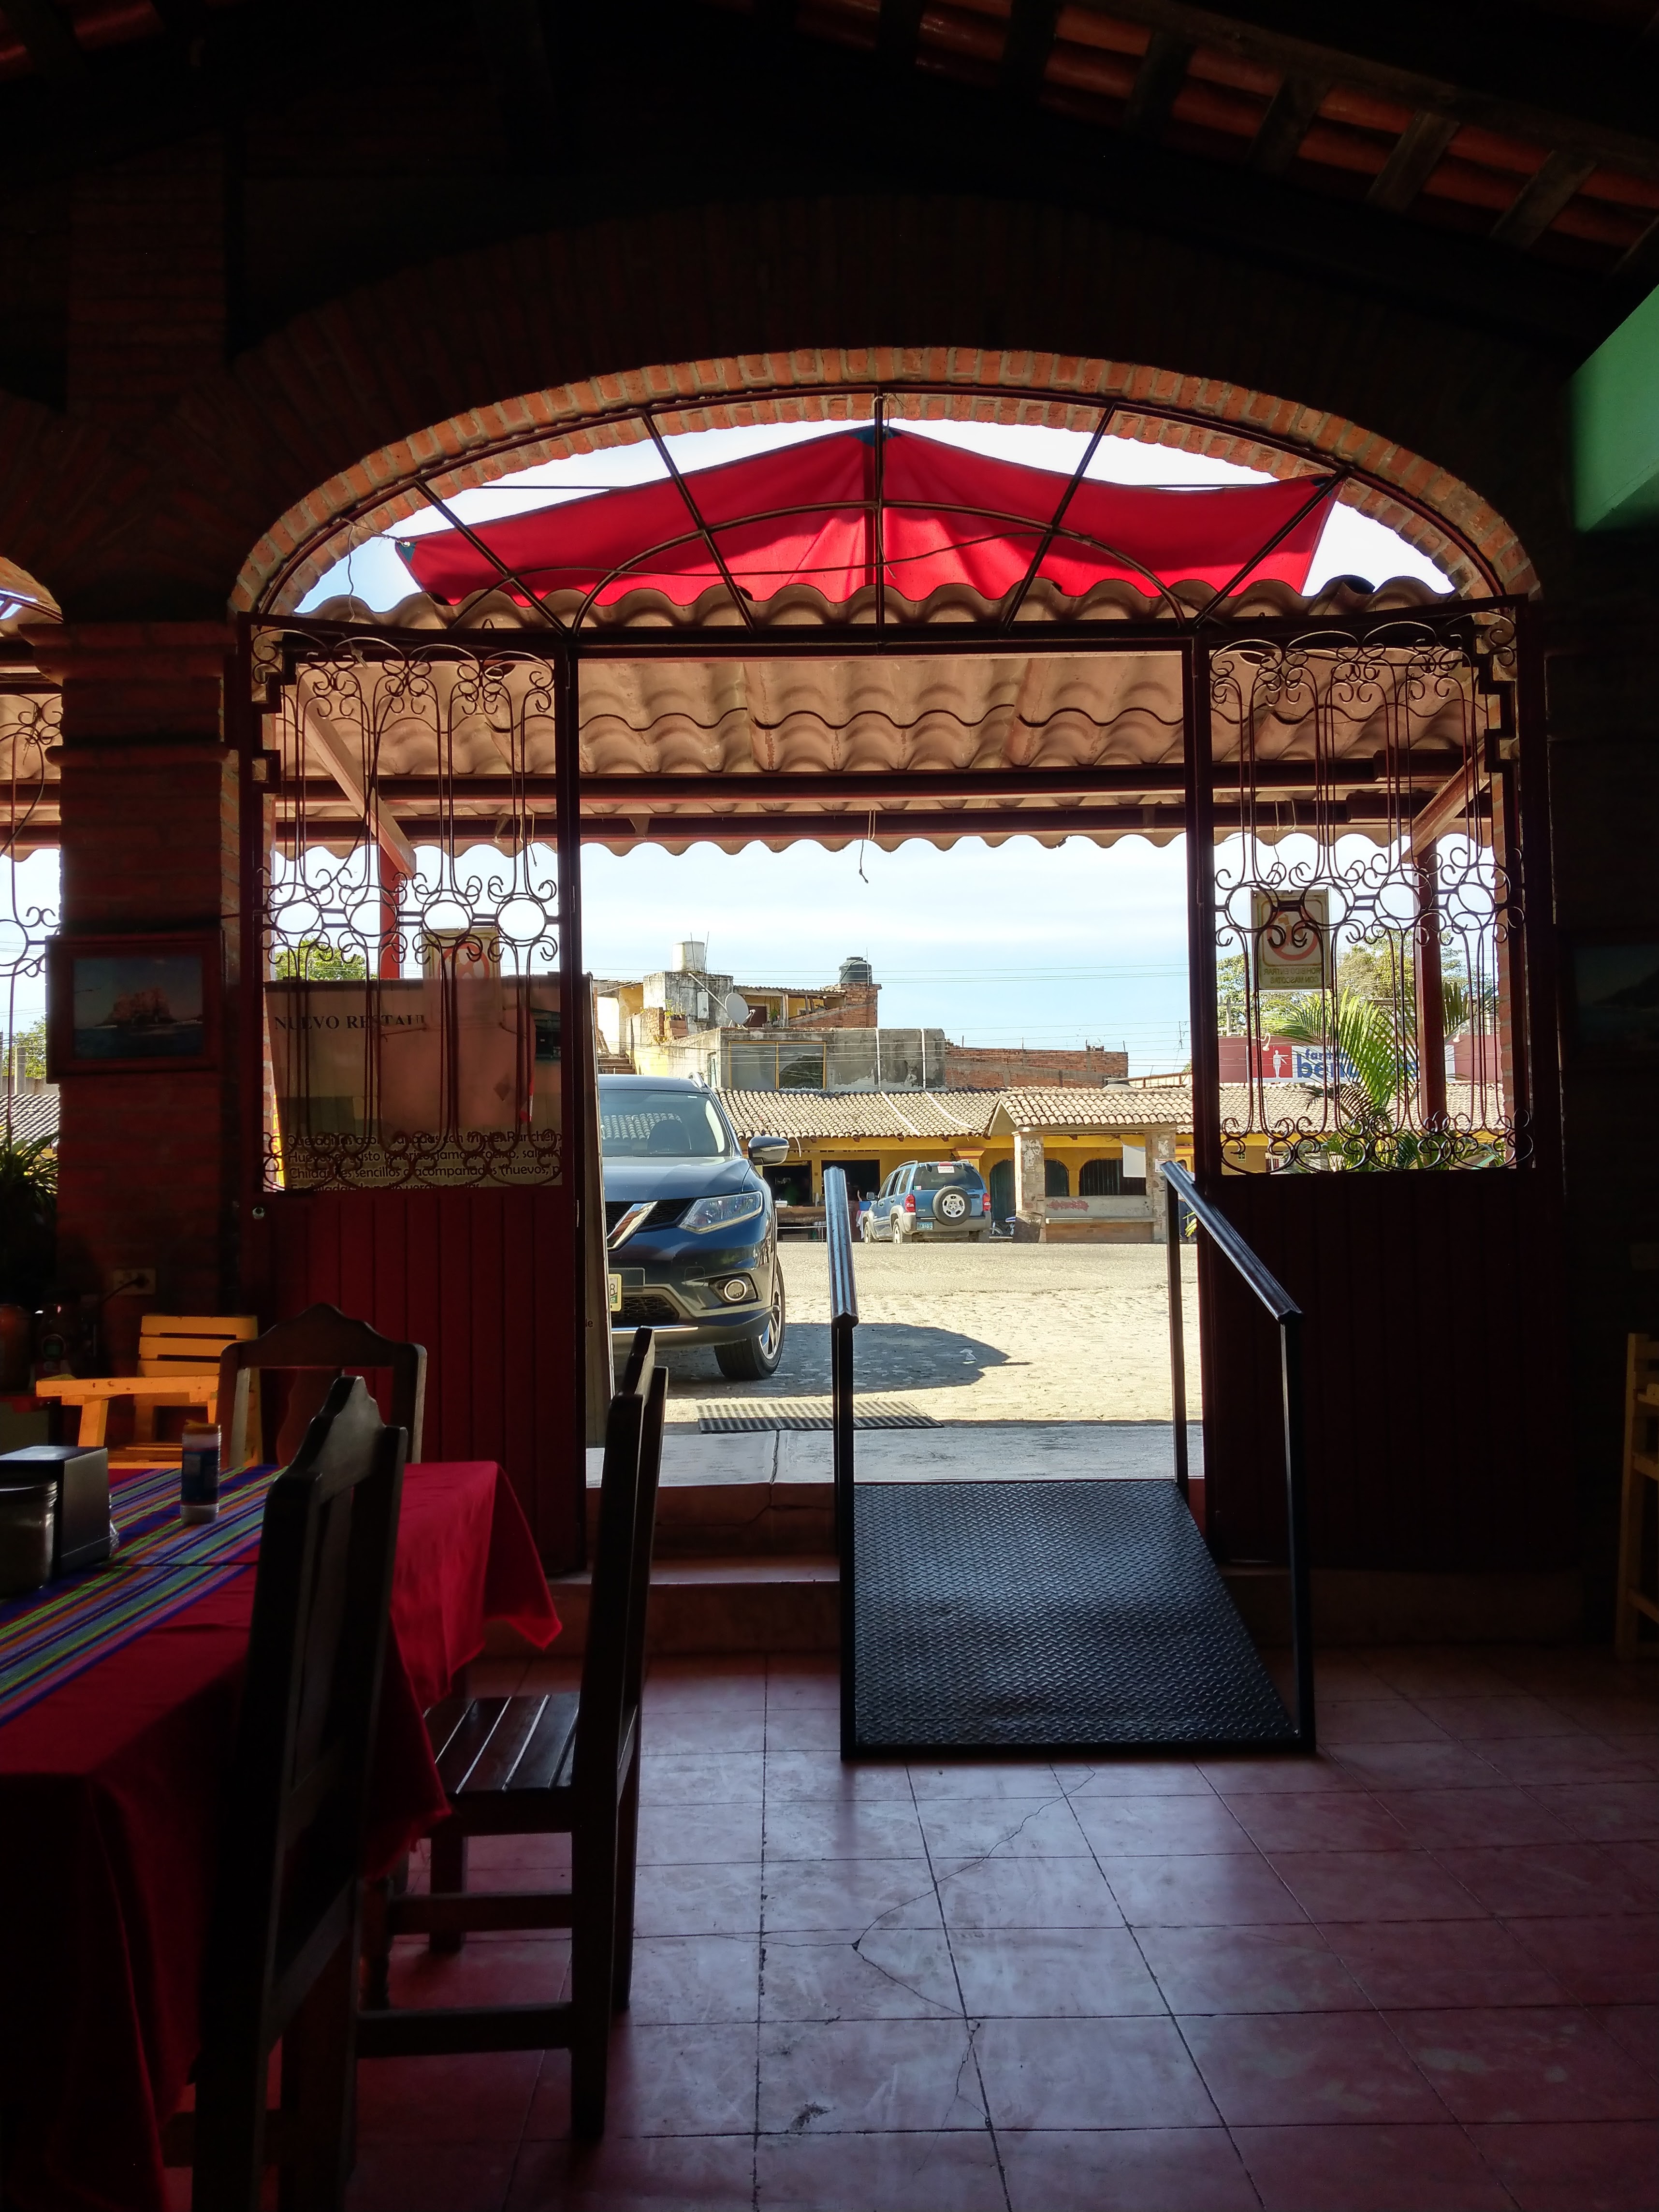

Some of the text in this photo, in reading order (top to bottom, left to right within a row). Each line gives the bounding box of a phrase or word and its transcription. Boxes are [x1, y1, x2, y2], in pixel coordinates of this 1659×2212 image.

[288, 1132, 352, 1147] Queadilas
[444, 1135, 463, 1143] on
[348, 1151, 380, 1163] usto
[436, 1150, 477, 1162] jam,
[290, 1166, 351, 1180] Chilaques
[355, 1166, 400, 1178] sencillos
